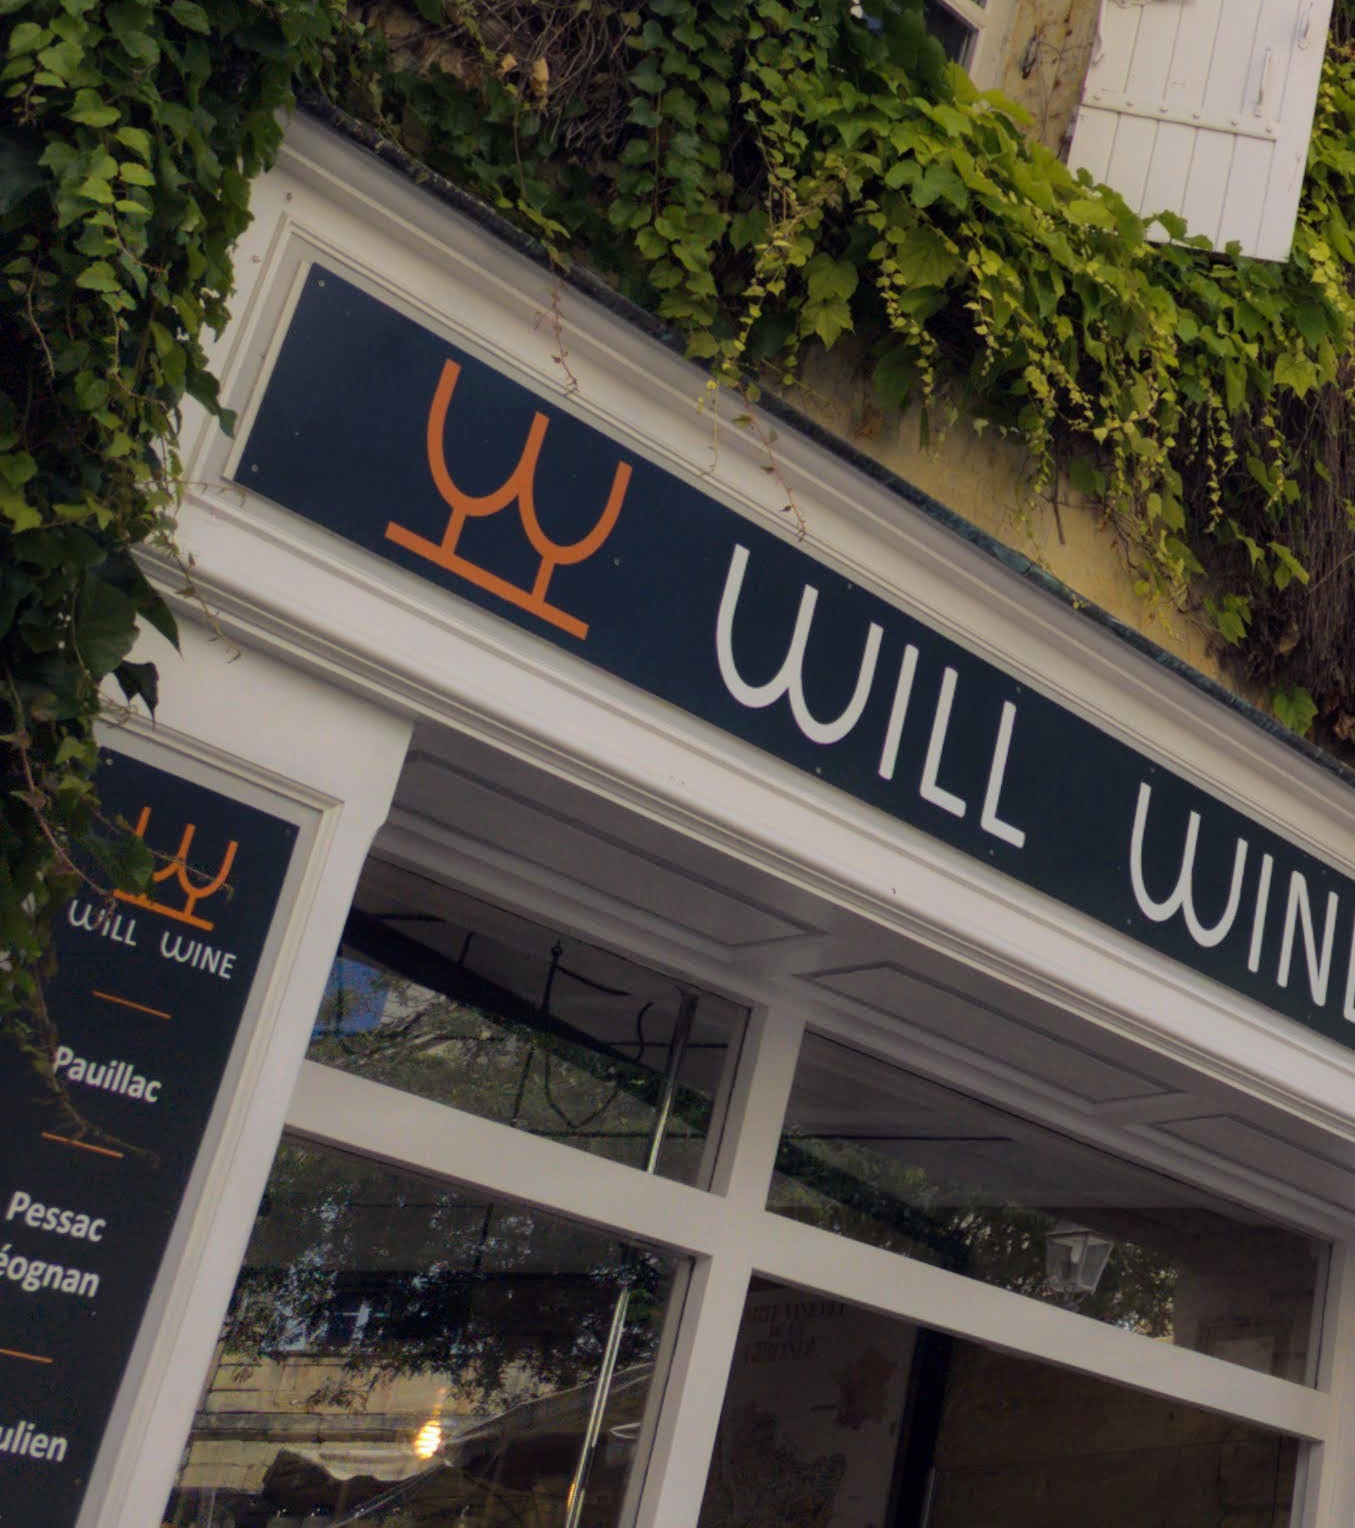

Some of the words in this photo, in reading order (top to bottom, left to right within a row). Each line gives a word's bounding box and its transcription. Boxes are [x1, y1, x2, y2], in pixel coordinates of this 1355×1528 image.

[715, 543, 1026, 850] WILL
[68, 899, 137, 947] WILL
[160, 931, 238, 979] WINE
[52, 1045, 162, 1103] Pauillac
[5, 1191, 107, 1243] Pessac
